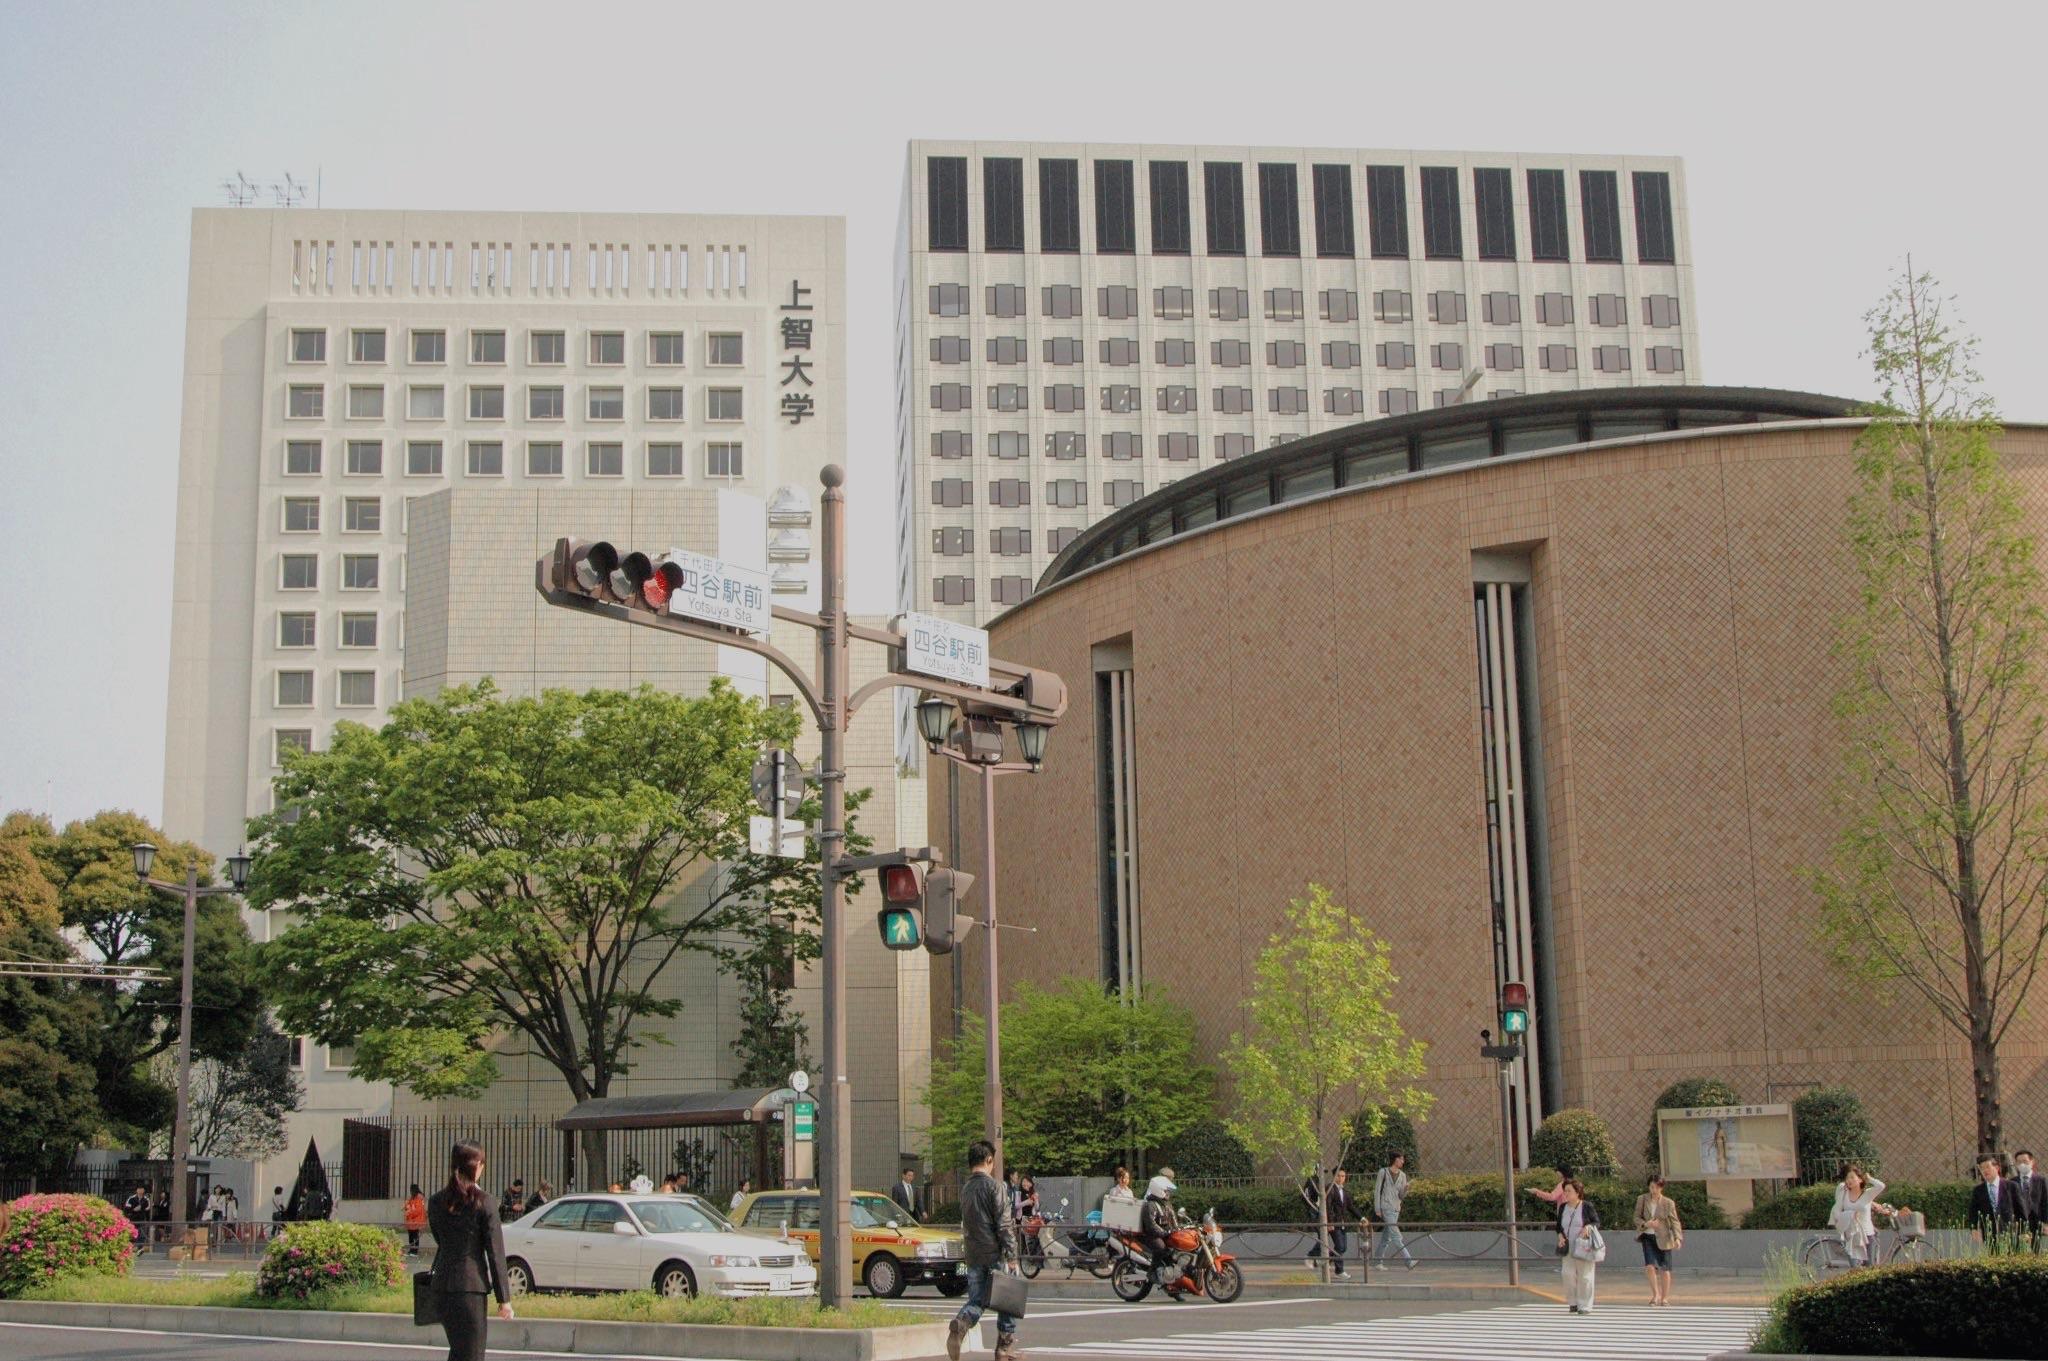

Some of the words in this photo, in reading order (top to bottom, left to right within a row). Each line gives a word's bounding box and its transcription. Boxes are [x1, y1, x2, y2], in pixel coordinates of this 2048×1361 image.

[780, 279, 814, 425] 上智大学
[680, 568, 763, 611] 四谷駅前
[688, 595, 730, 619] Yotsuya
[734, 607, 752, 623] Sta
[914, 628, 983, 666] 四谷駅前
